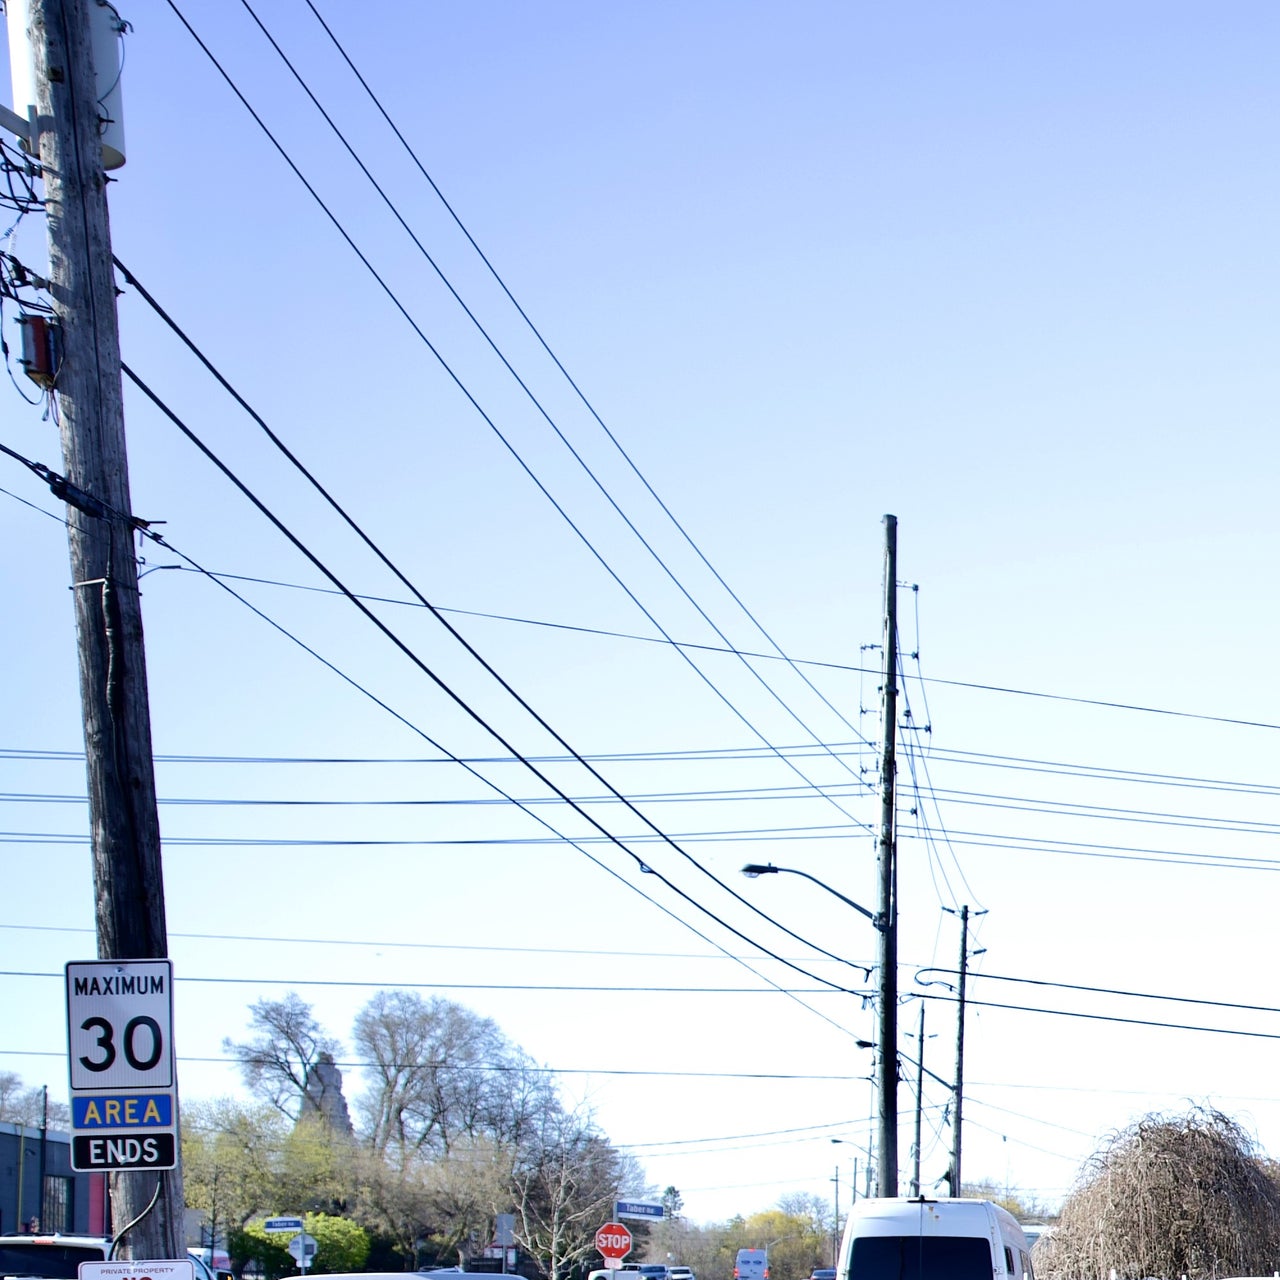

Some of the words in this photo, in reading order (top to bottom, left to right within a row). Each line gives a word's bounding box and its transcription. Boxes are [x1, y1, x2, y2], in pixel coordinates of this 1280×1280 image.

[74, 975, 164, 996] MAXIMUM
[79, 1015, 163, 1073] 30
[83, 1099, 161, 1125] AREA
[89, 1137, 159, 1164] ENDS
[598, 1233, 630, 1249] STOP
